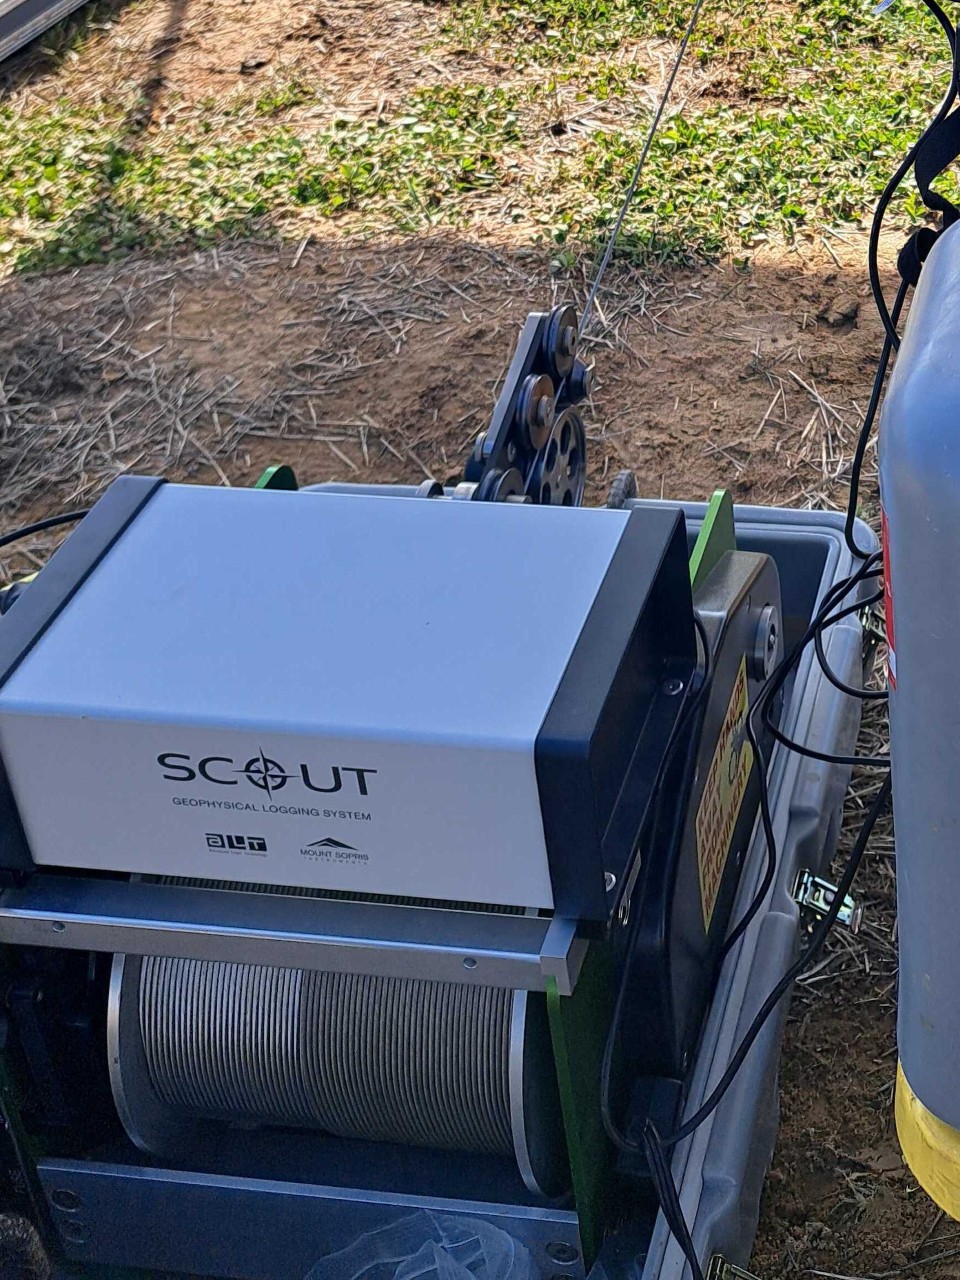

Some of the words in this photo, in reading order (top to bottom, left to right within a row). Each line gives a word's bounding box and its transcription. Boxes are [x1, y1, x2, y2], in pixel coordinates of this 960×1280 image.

[157, 748, 378, 799] SCOUT
[699, 757, 718, 831] KEEP
[719, 669, 744, 763] HANDS
[172, 797, 259, 812] GEOPHYSICAL
[262, 804, 320, 817] LOGGING
[323, 809, 372, 821] SYSTEM
[701, 777, 721, 870] AWAY
[703, 803, 723, 891] FROM
[705, 752, 746, 917] MACHINERY
[300, 848, 333, 858] MOUNT
[335, 851, 369, 860] SOPRIS
